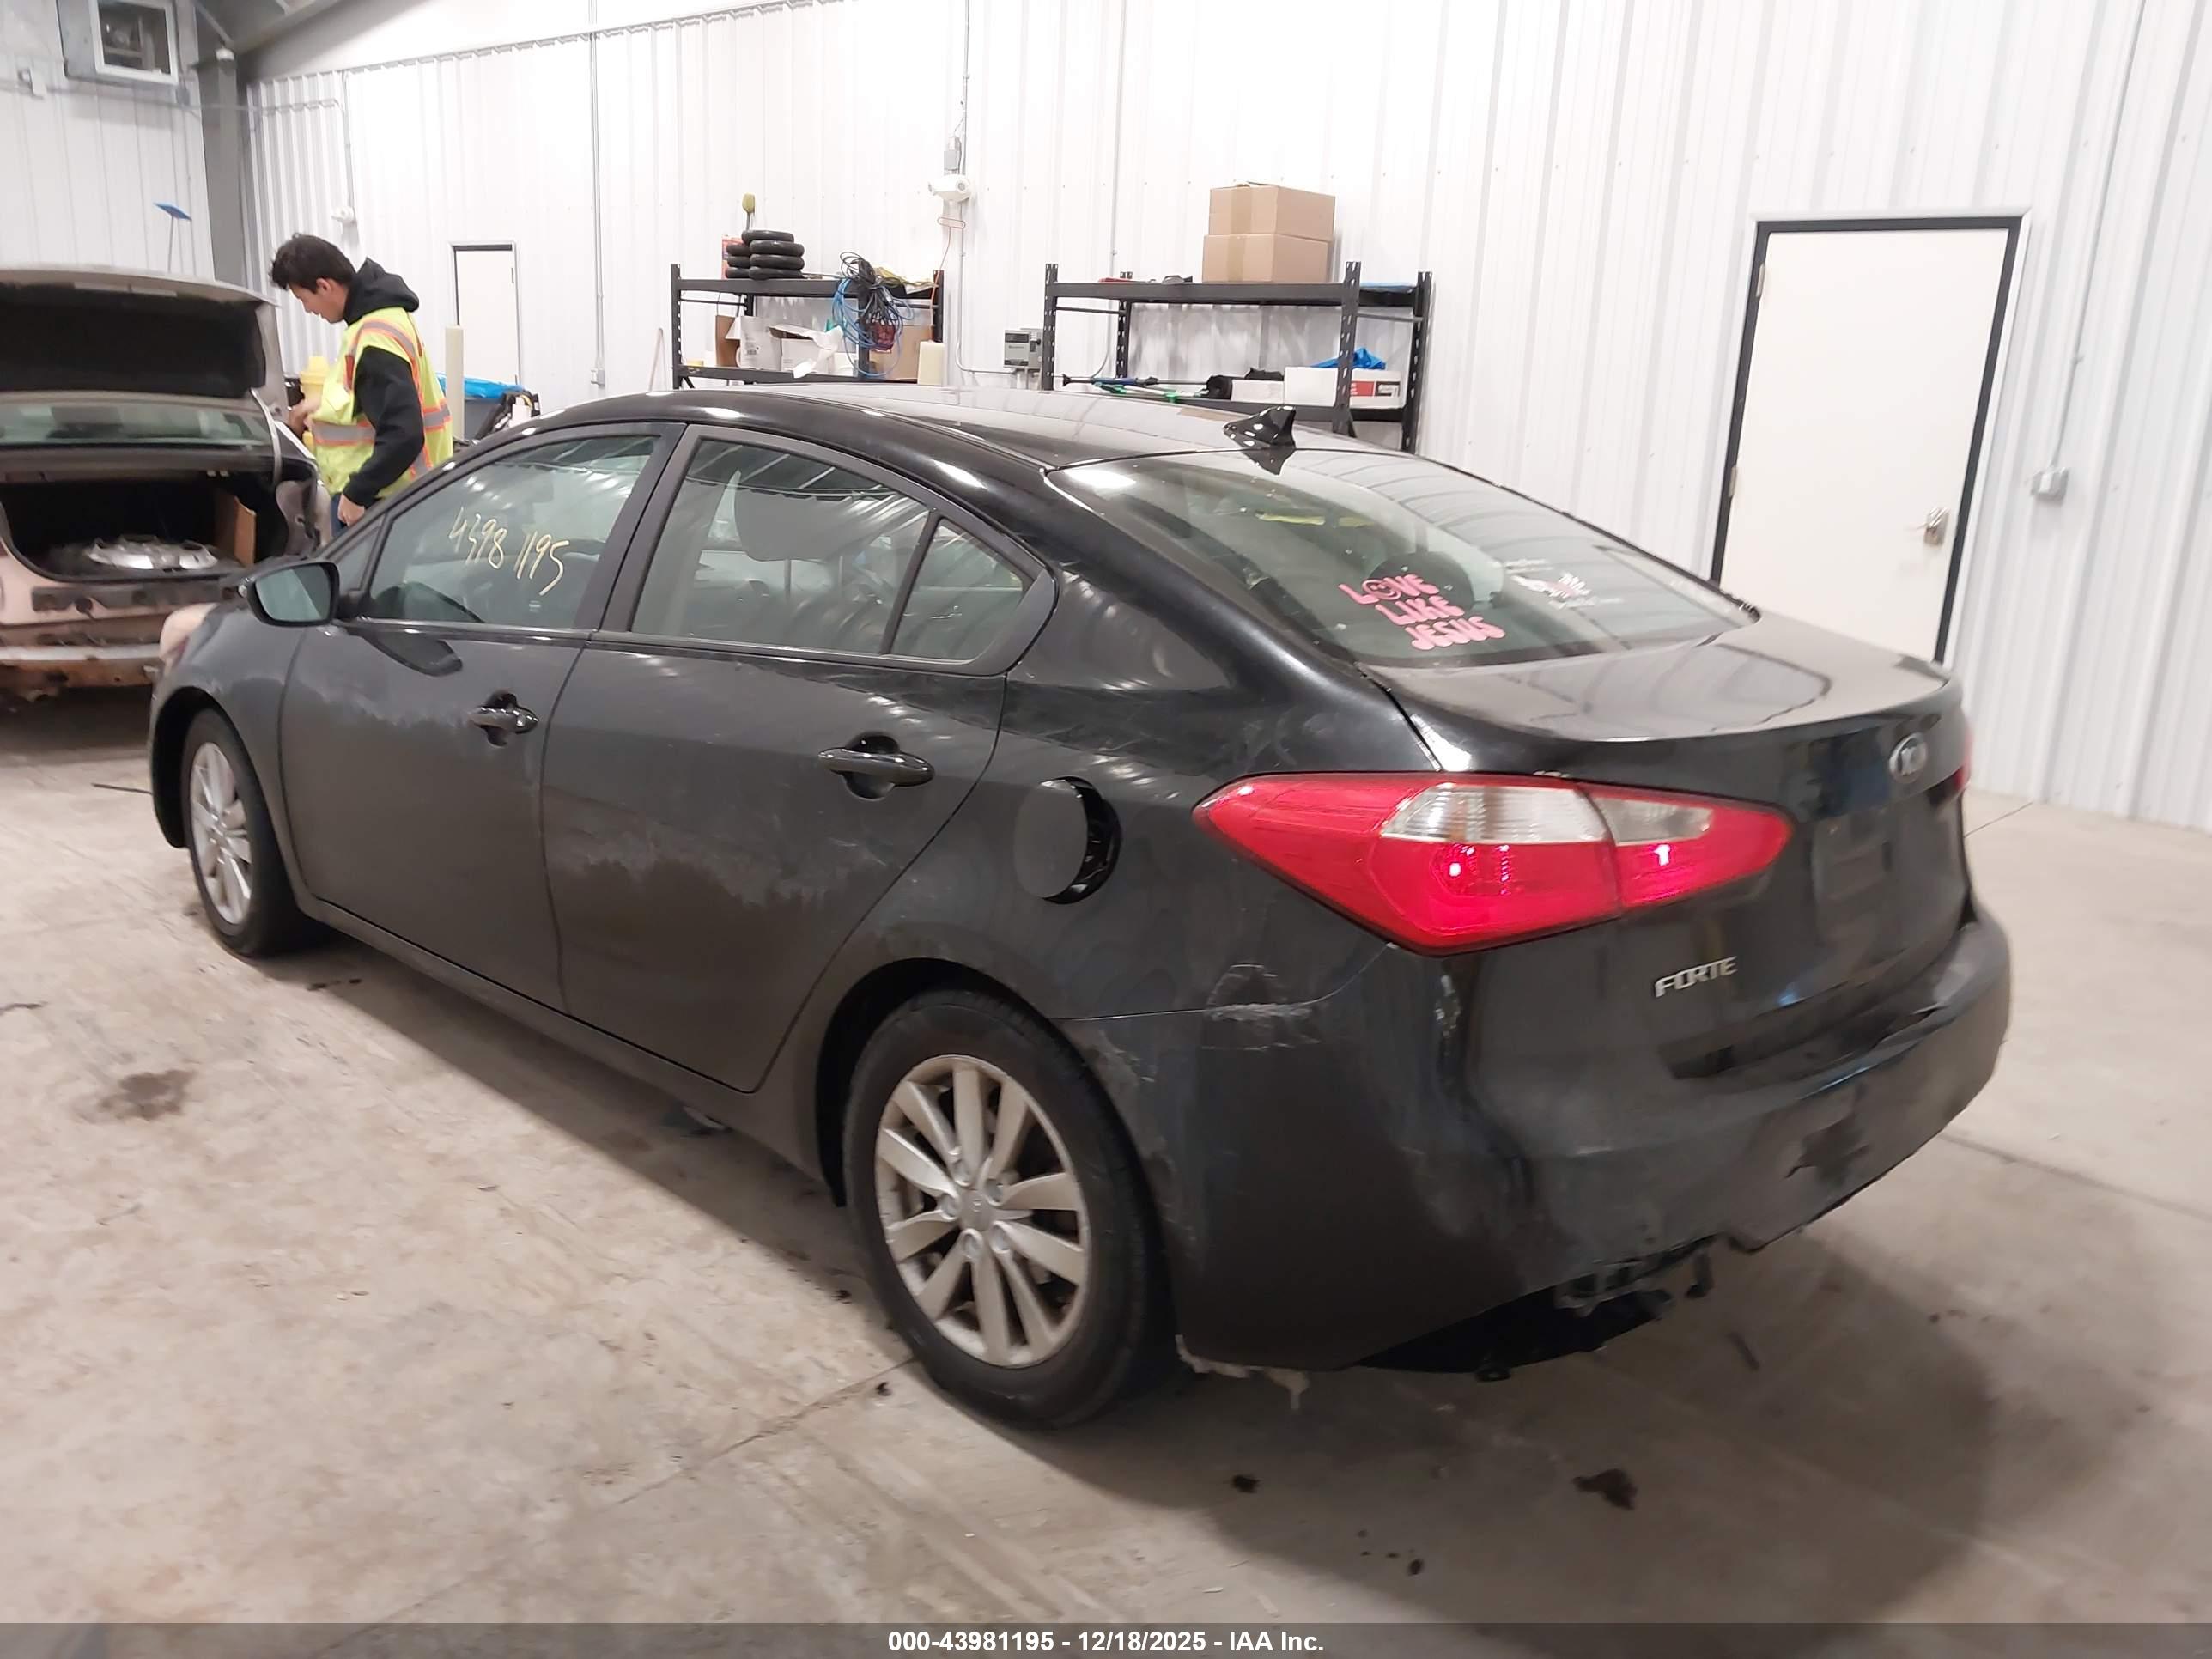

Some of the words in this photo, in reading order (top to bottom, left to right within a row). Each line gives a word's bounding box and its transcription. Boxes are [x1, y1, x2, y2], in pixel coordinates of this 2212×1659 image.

[448, 507, 507, 568] 4398
[514, 531, 569, 595] 1195
[1338, 574, 1440, 605] LOVE
[1375, 595, 1465, 626] LIKE
[1404, 616, 1506, 650] JESUS
[1655, 956, 1738, 998] FORTE
